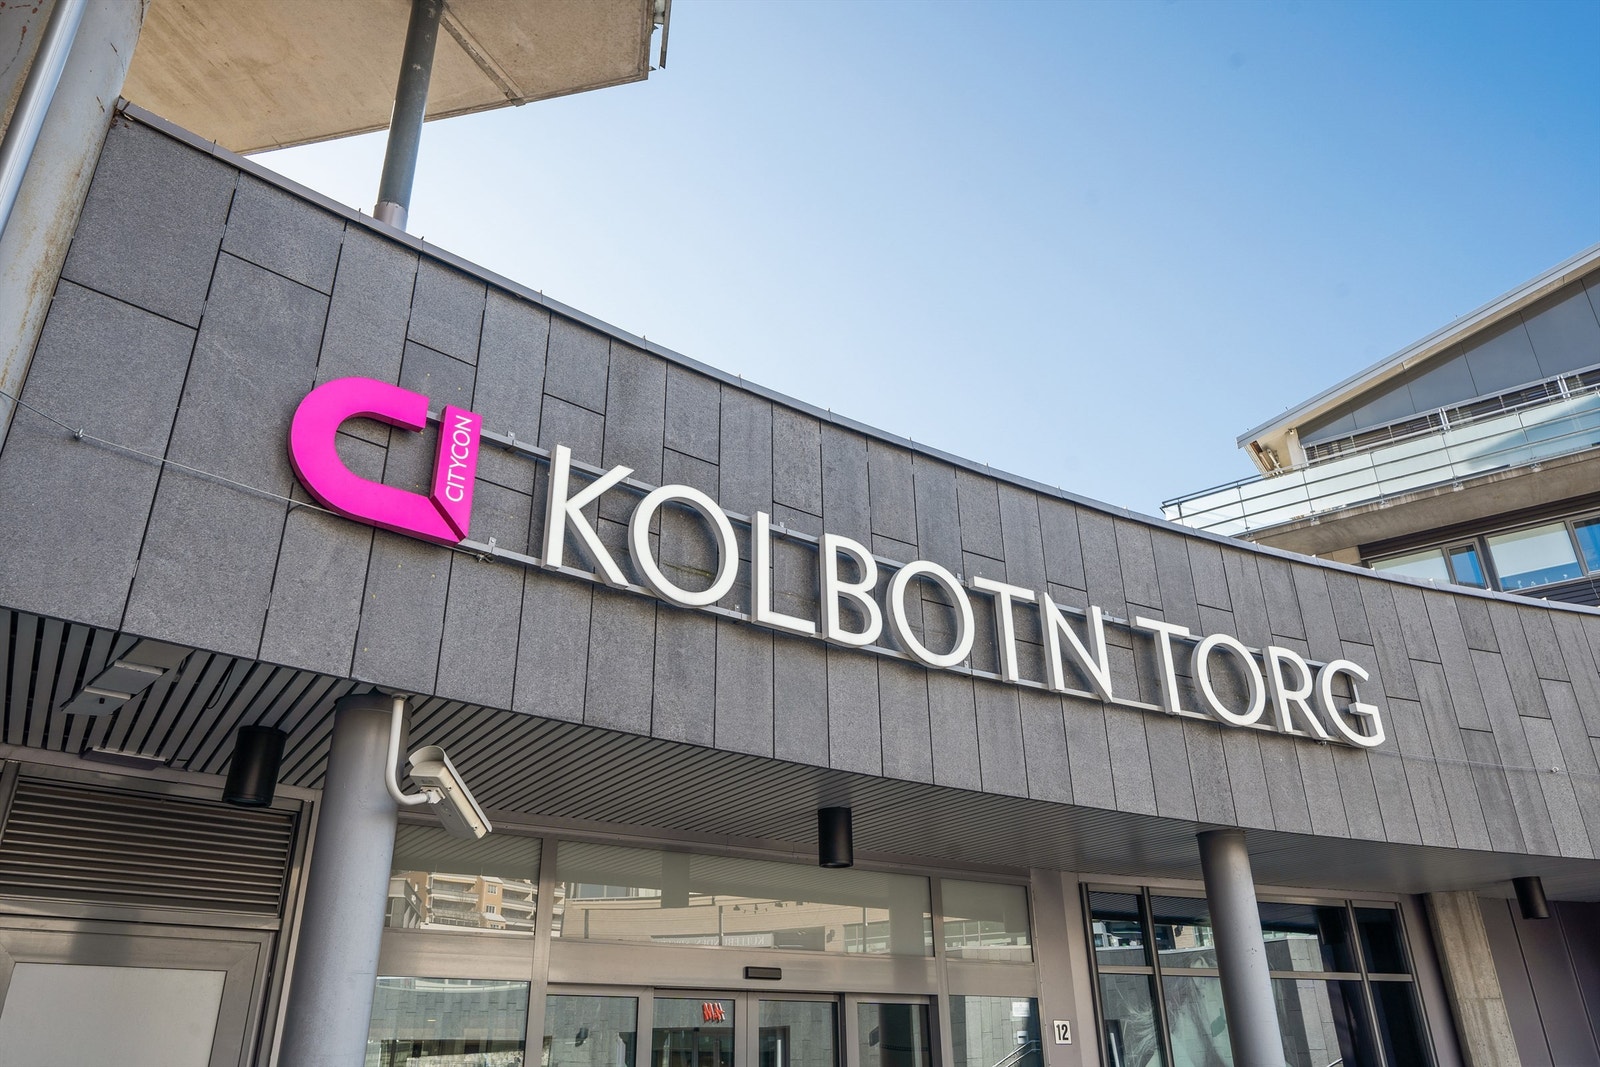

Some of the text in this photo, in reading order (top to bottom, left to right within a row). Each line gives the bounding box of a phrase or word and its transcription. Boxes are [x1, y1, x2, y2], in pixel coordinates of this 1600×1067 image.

[445, 415, 472, 502] CITYCON
[541, 444, 1386, 748] KOLBOTN TORG
[1056, 1024, 1069, 1041] 12
